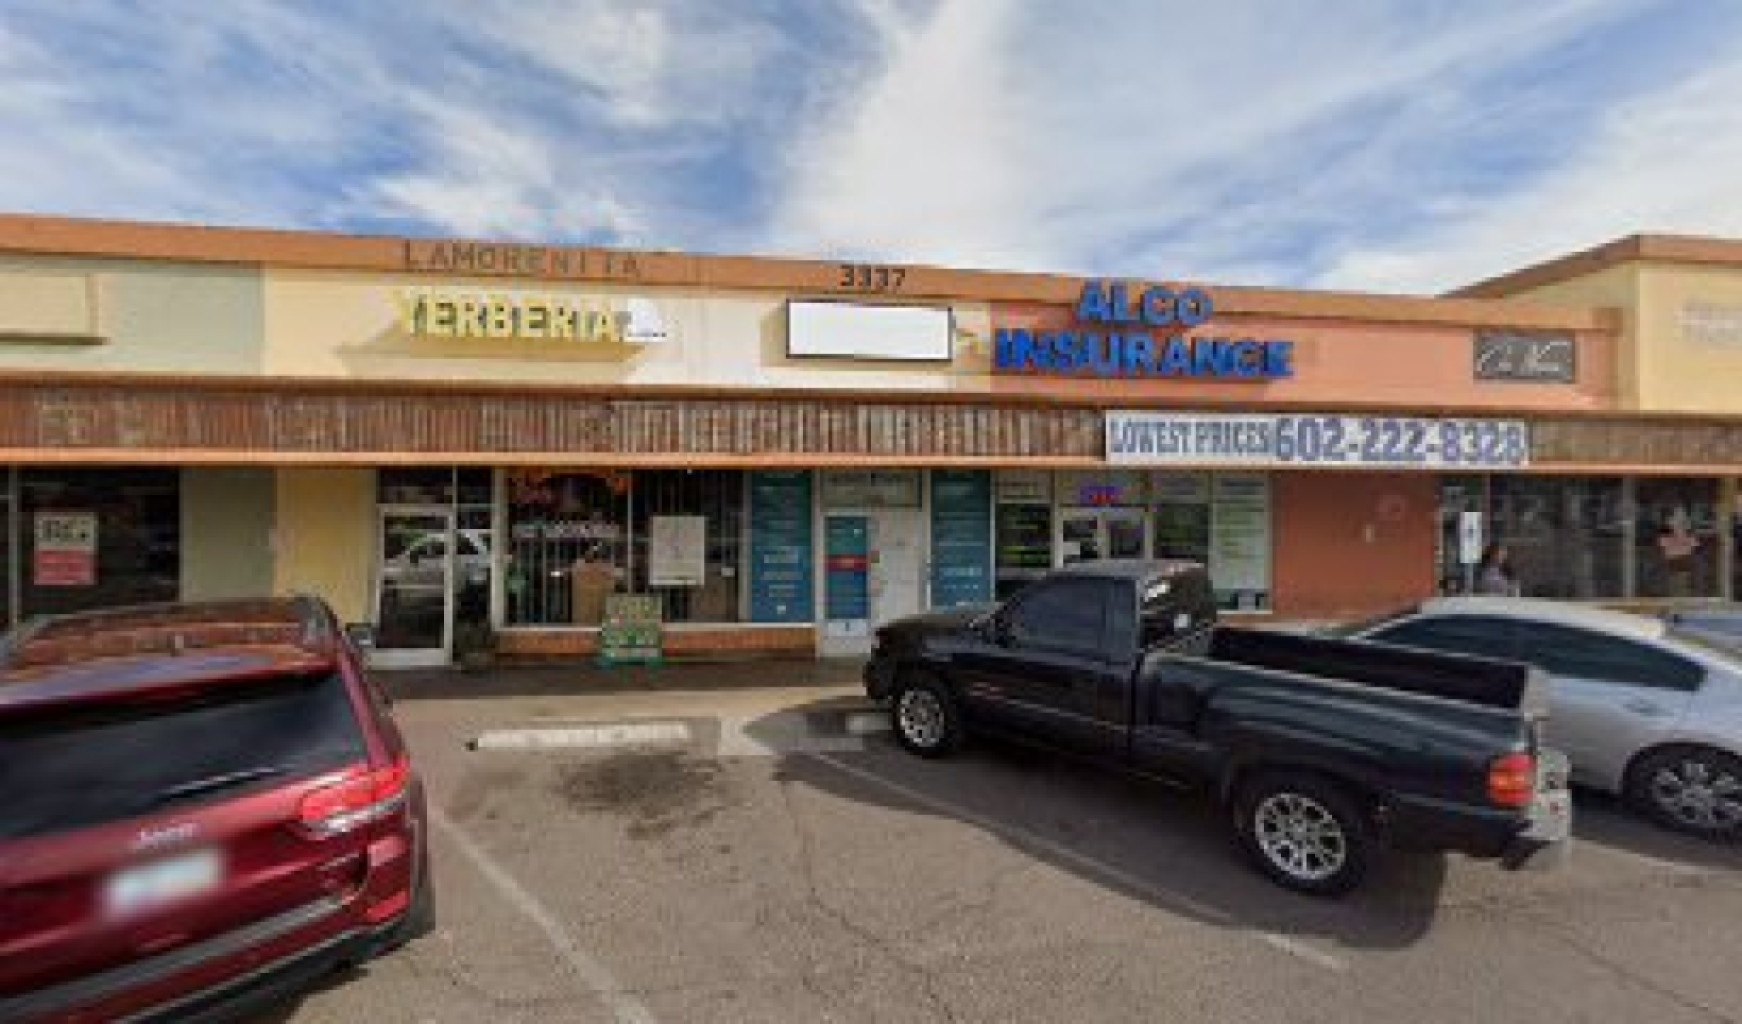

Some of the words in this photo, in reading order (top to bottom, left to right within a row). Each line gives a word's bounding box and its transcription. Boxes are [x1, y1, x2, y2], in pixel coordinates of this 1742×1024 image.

[401, 290, 626, 342] YERBERIA
[1077, 281, 1214, 326] ALCO
[994, 329, 1295, 378] INSURANCE
[1110, 420, 1191, 453] LOWEST
[1199, 420, 1271, 456] PRICES
